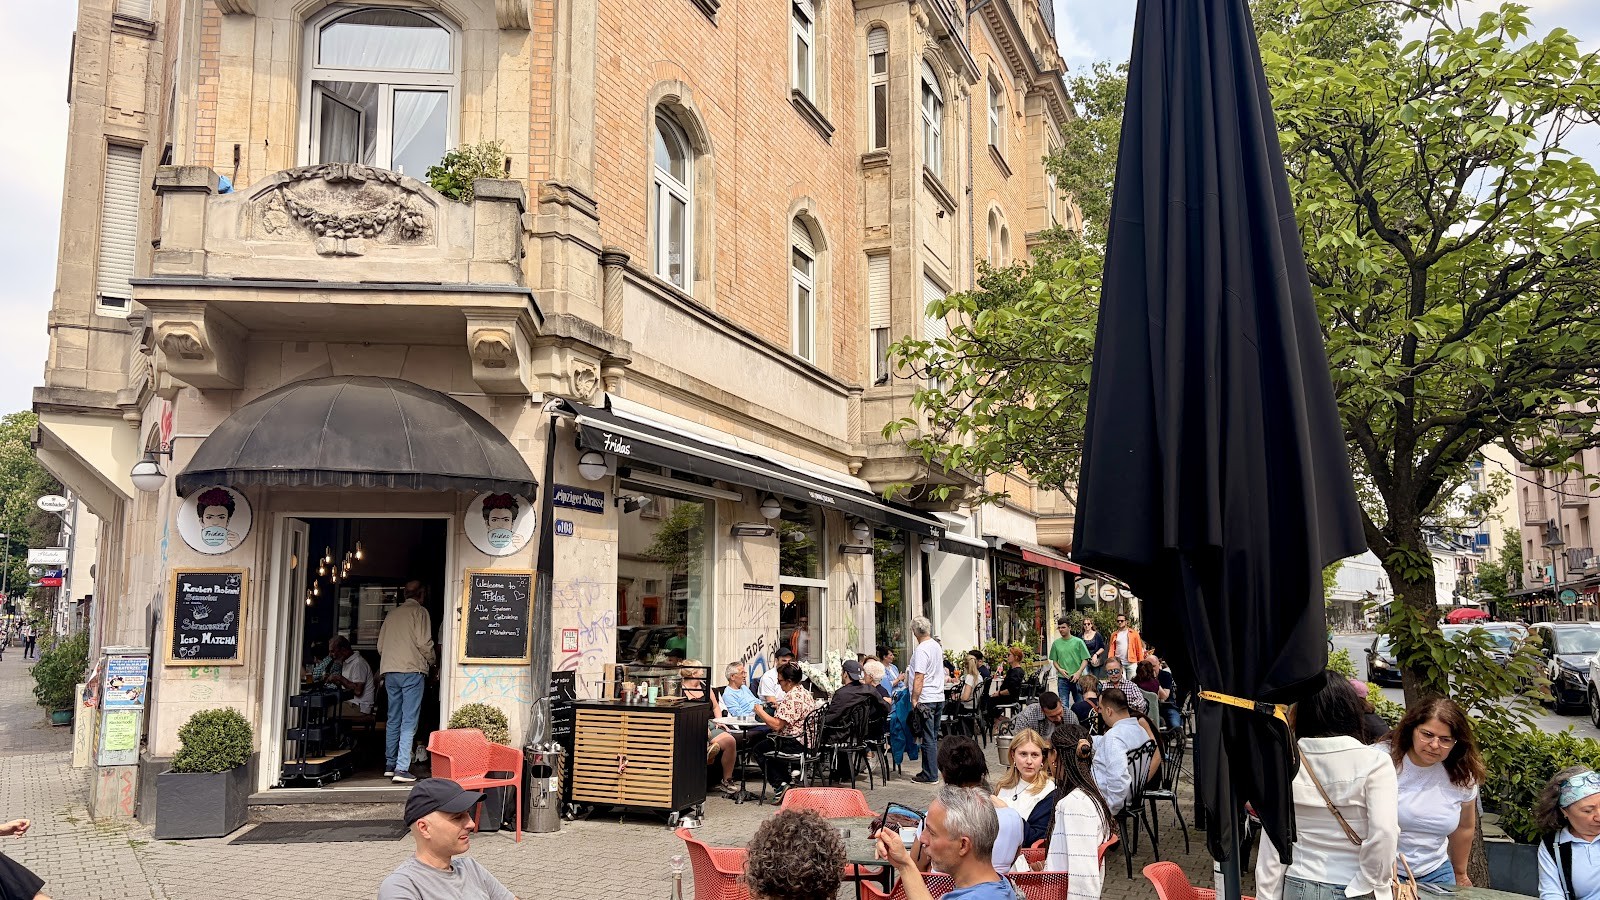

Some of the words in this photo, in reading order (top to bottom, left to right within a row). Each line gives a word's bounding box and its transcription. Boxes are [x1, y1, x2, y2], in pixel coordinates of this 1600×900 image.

[602, 432, 631, 456] Fridas
[41, 500, 66, 508] Krombacher
[583, 492, 604, 509] Strasse
[475, 578, 505, 589] Welcome
[508, 581, 516, 590] to
[474, 604, 489, 613] Alle
